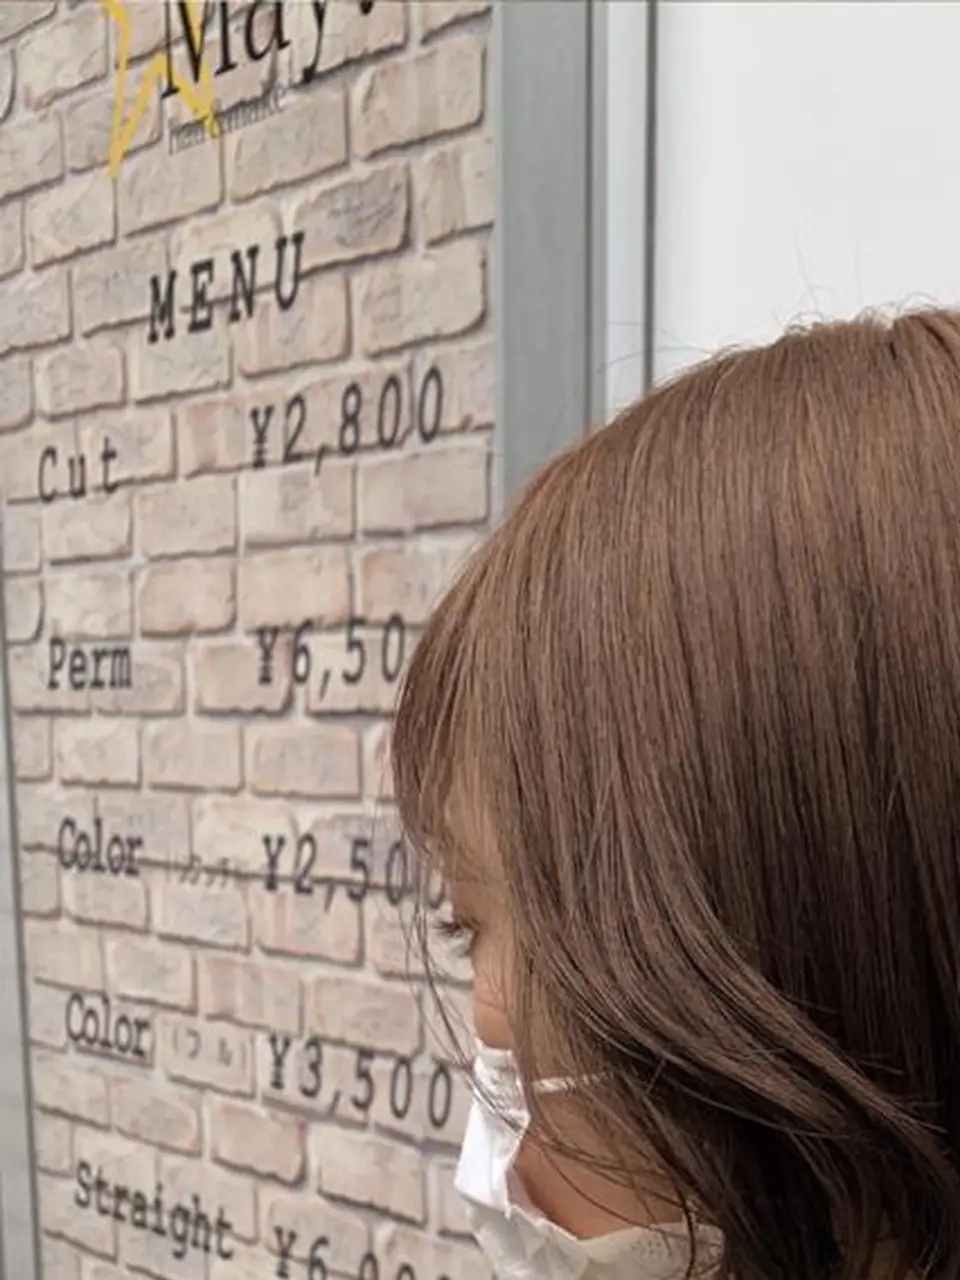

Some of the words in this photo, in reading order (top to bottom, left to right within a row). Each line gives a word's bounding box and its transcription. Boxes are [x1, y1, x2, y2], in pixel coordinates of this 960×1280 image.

[147, 231, 305, 344] MENU
[38, 436, 119, 502] Cut
[249, 365, 444, 476] ¥2,800
[47, 637, 134, 691] Perm
[57, 817, 143, 877] Color
[65, 992, 152, 1058] Color
[270, 1035, 453, 1130] ¥3,500
[73, 1160, 235, 1262] Straight
